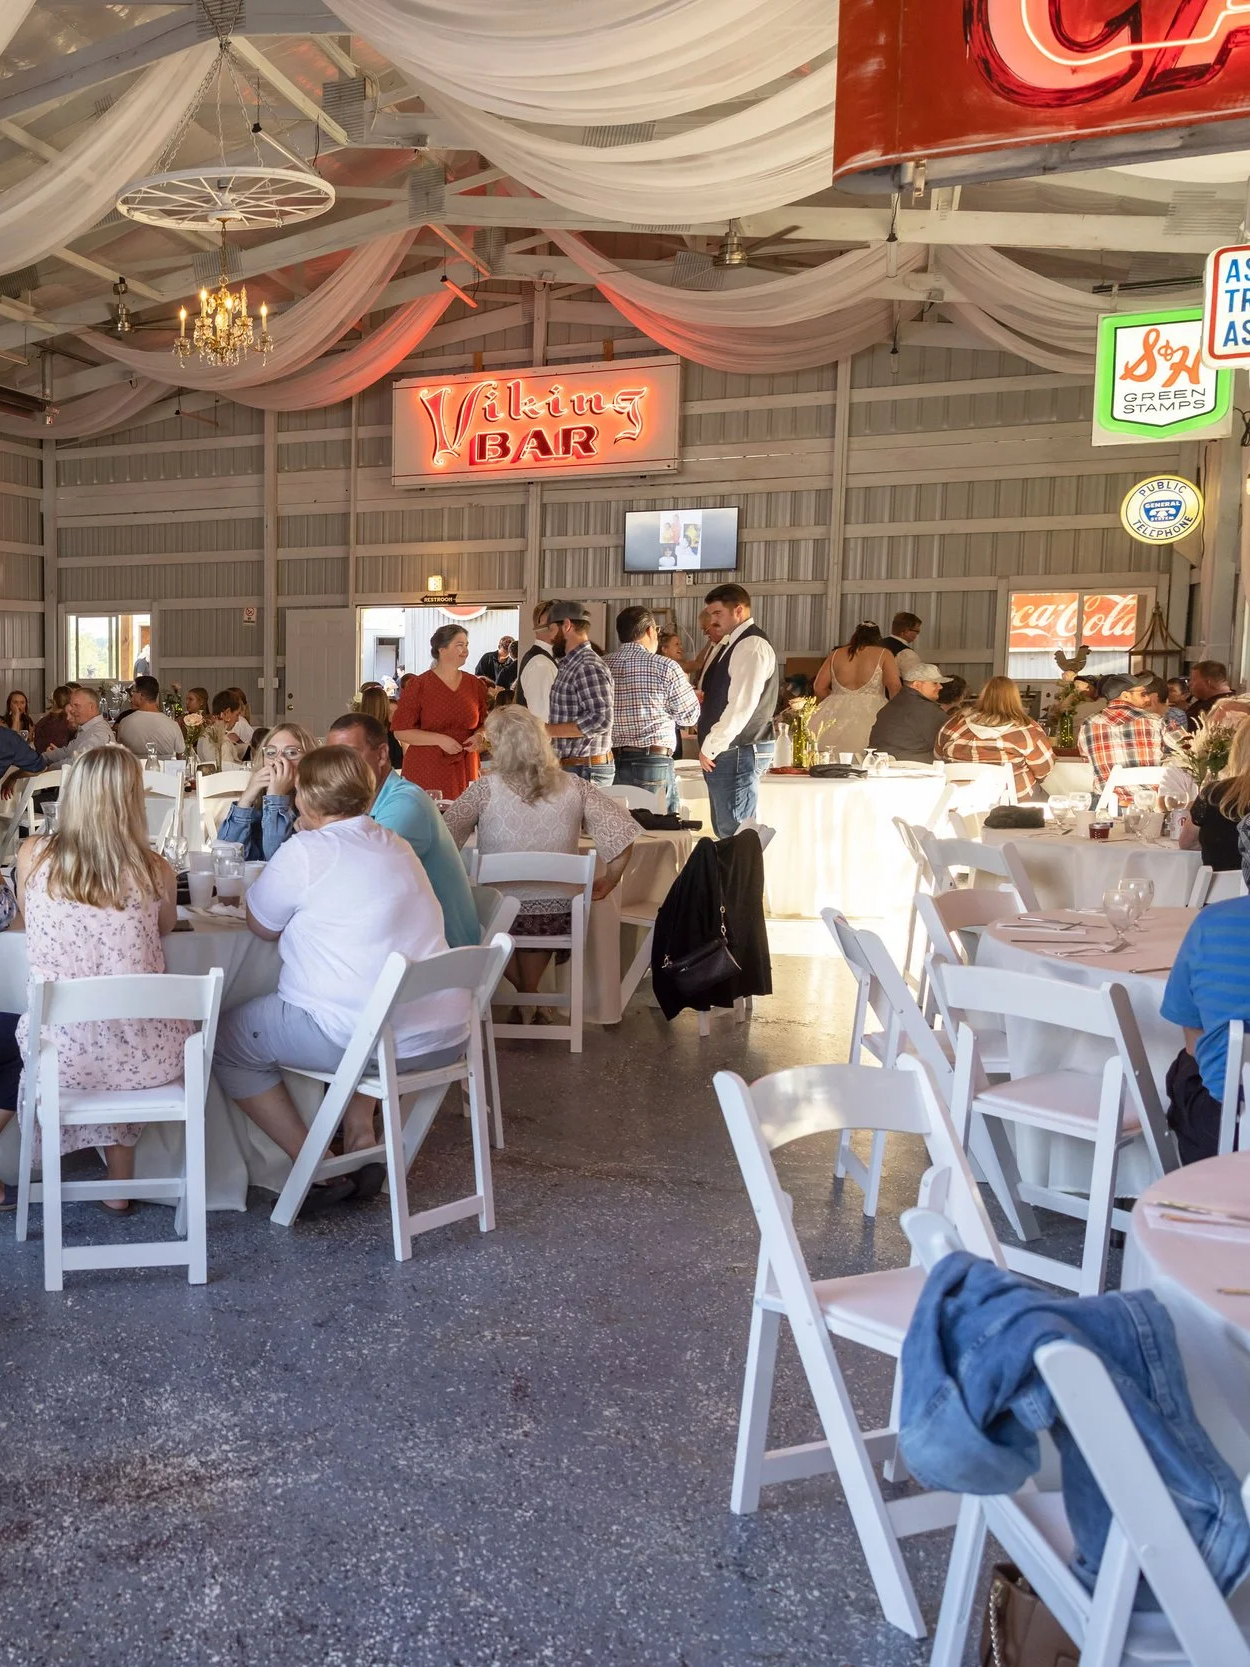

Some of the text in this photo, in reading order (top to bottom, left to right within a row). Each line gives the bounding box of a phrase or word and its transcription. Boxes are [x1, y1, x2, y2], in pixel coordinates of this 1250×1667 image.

[1119, 328, 1202, 388] S&H
[1123, 387, 1206, 403] GREEN
[1122, 399, 1206, 415] STAMPS
[419, 379, 648, 465] Viking
[472, 424, 600, 463] BAR
[1138, 481, 1187, 497] PUBLIC
[1144, 501, 1181, 509] GENERAL
[1132, 516, 1193, 538] TELEPHONE
